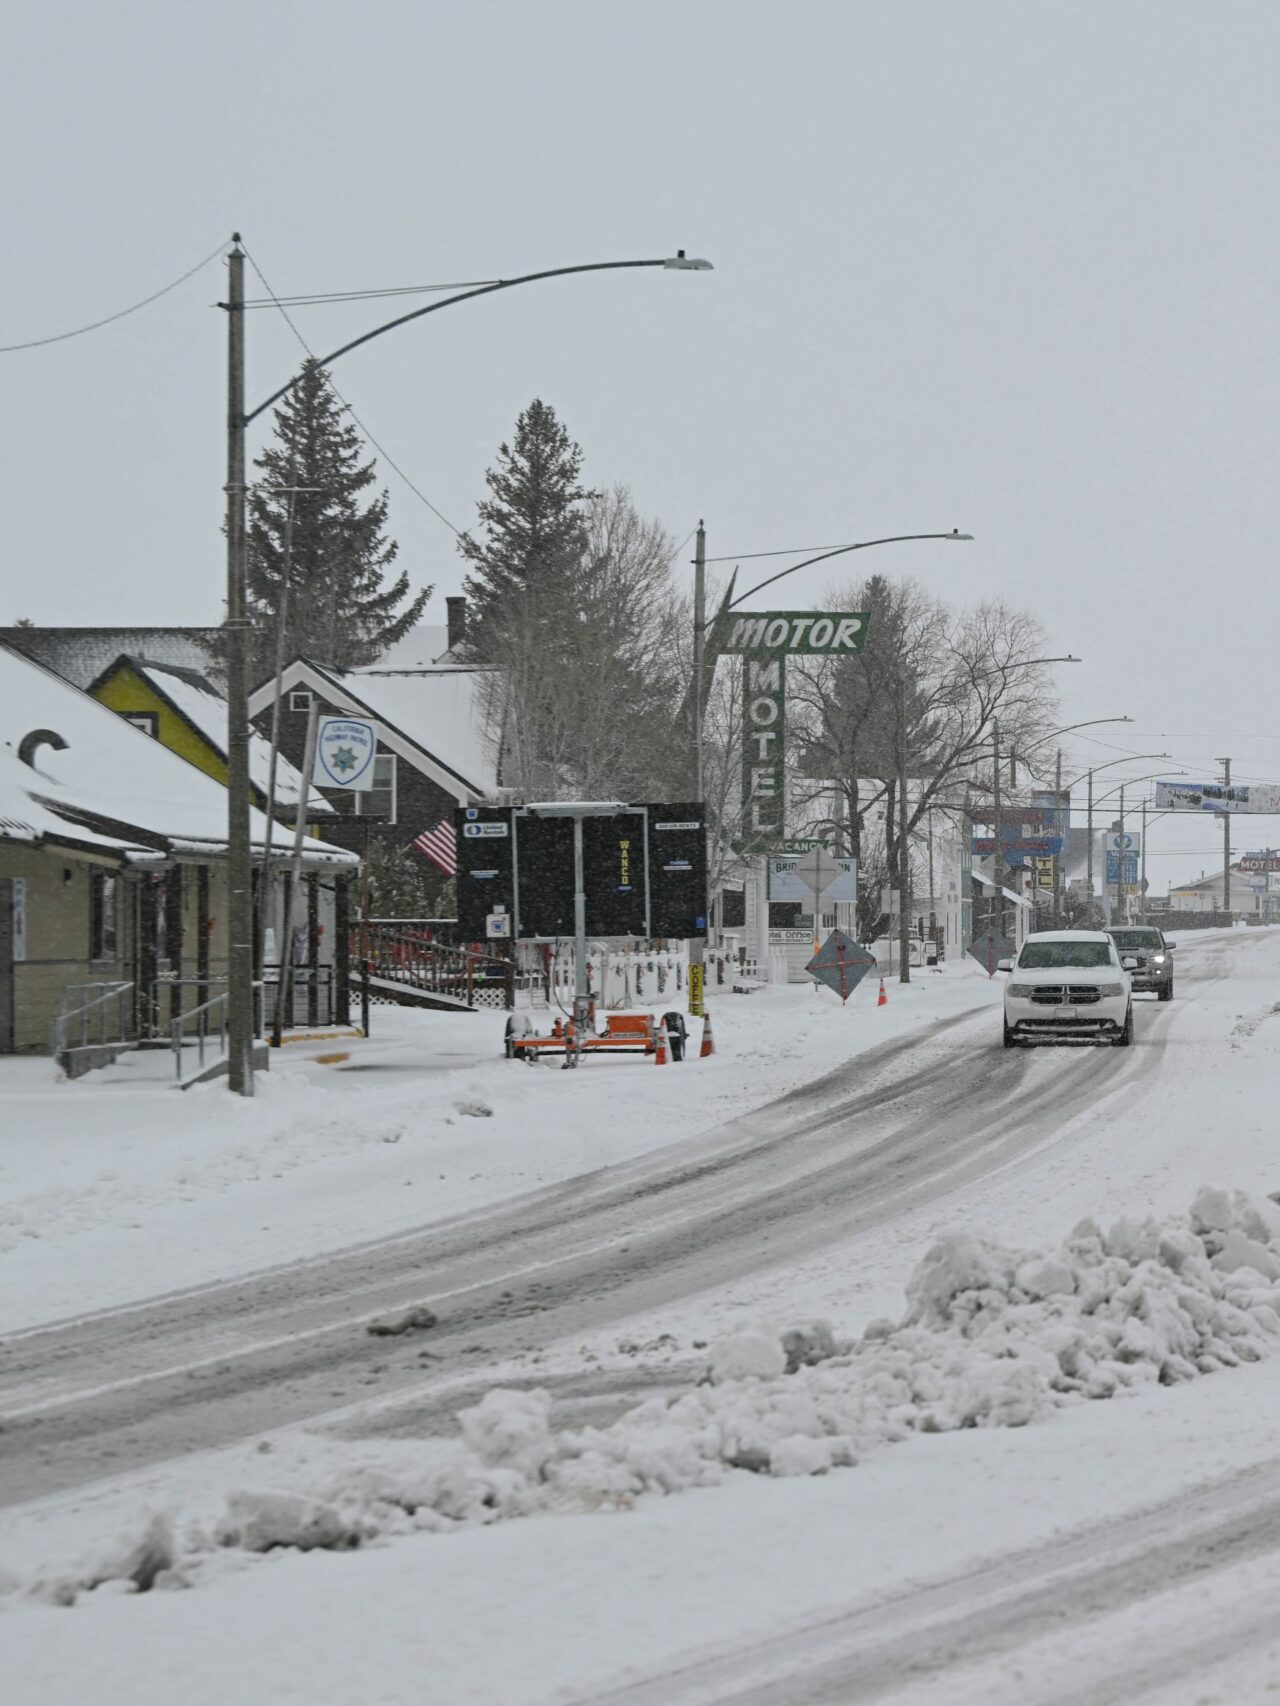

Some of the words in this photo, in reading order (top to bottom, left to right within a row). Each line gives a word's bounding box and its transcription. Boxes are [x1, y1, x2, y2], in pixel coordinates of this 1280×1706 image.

[727, 618, 862, 649] MOTOR
[749, 660, 781, 833] MOTEL
[619, 840, 631, 885] WANCO
[1240, 860, 1280, 870] MOTEL
[785, 931, 812, 939] Office
[691, 964, 700, 1017] COFFEE
